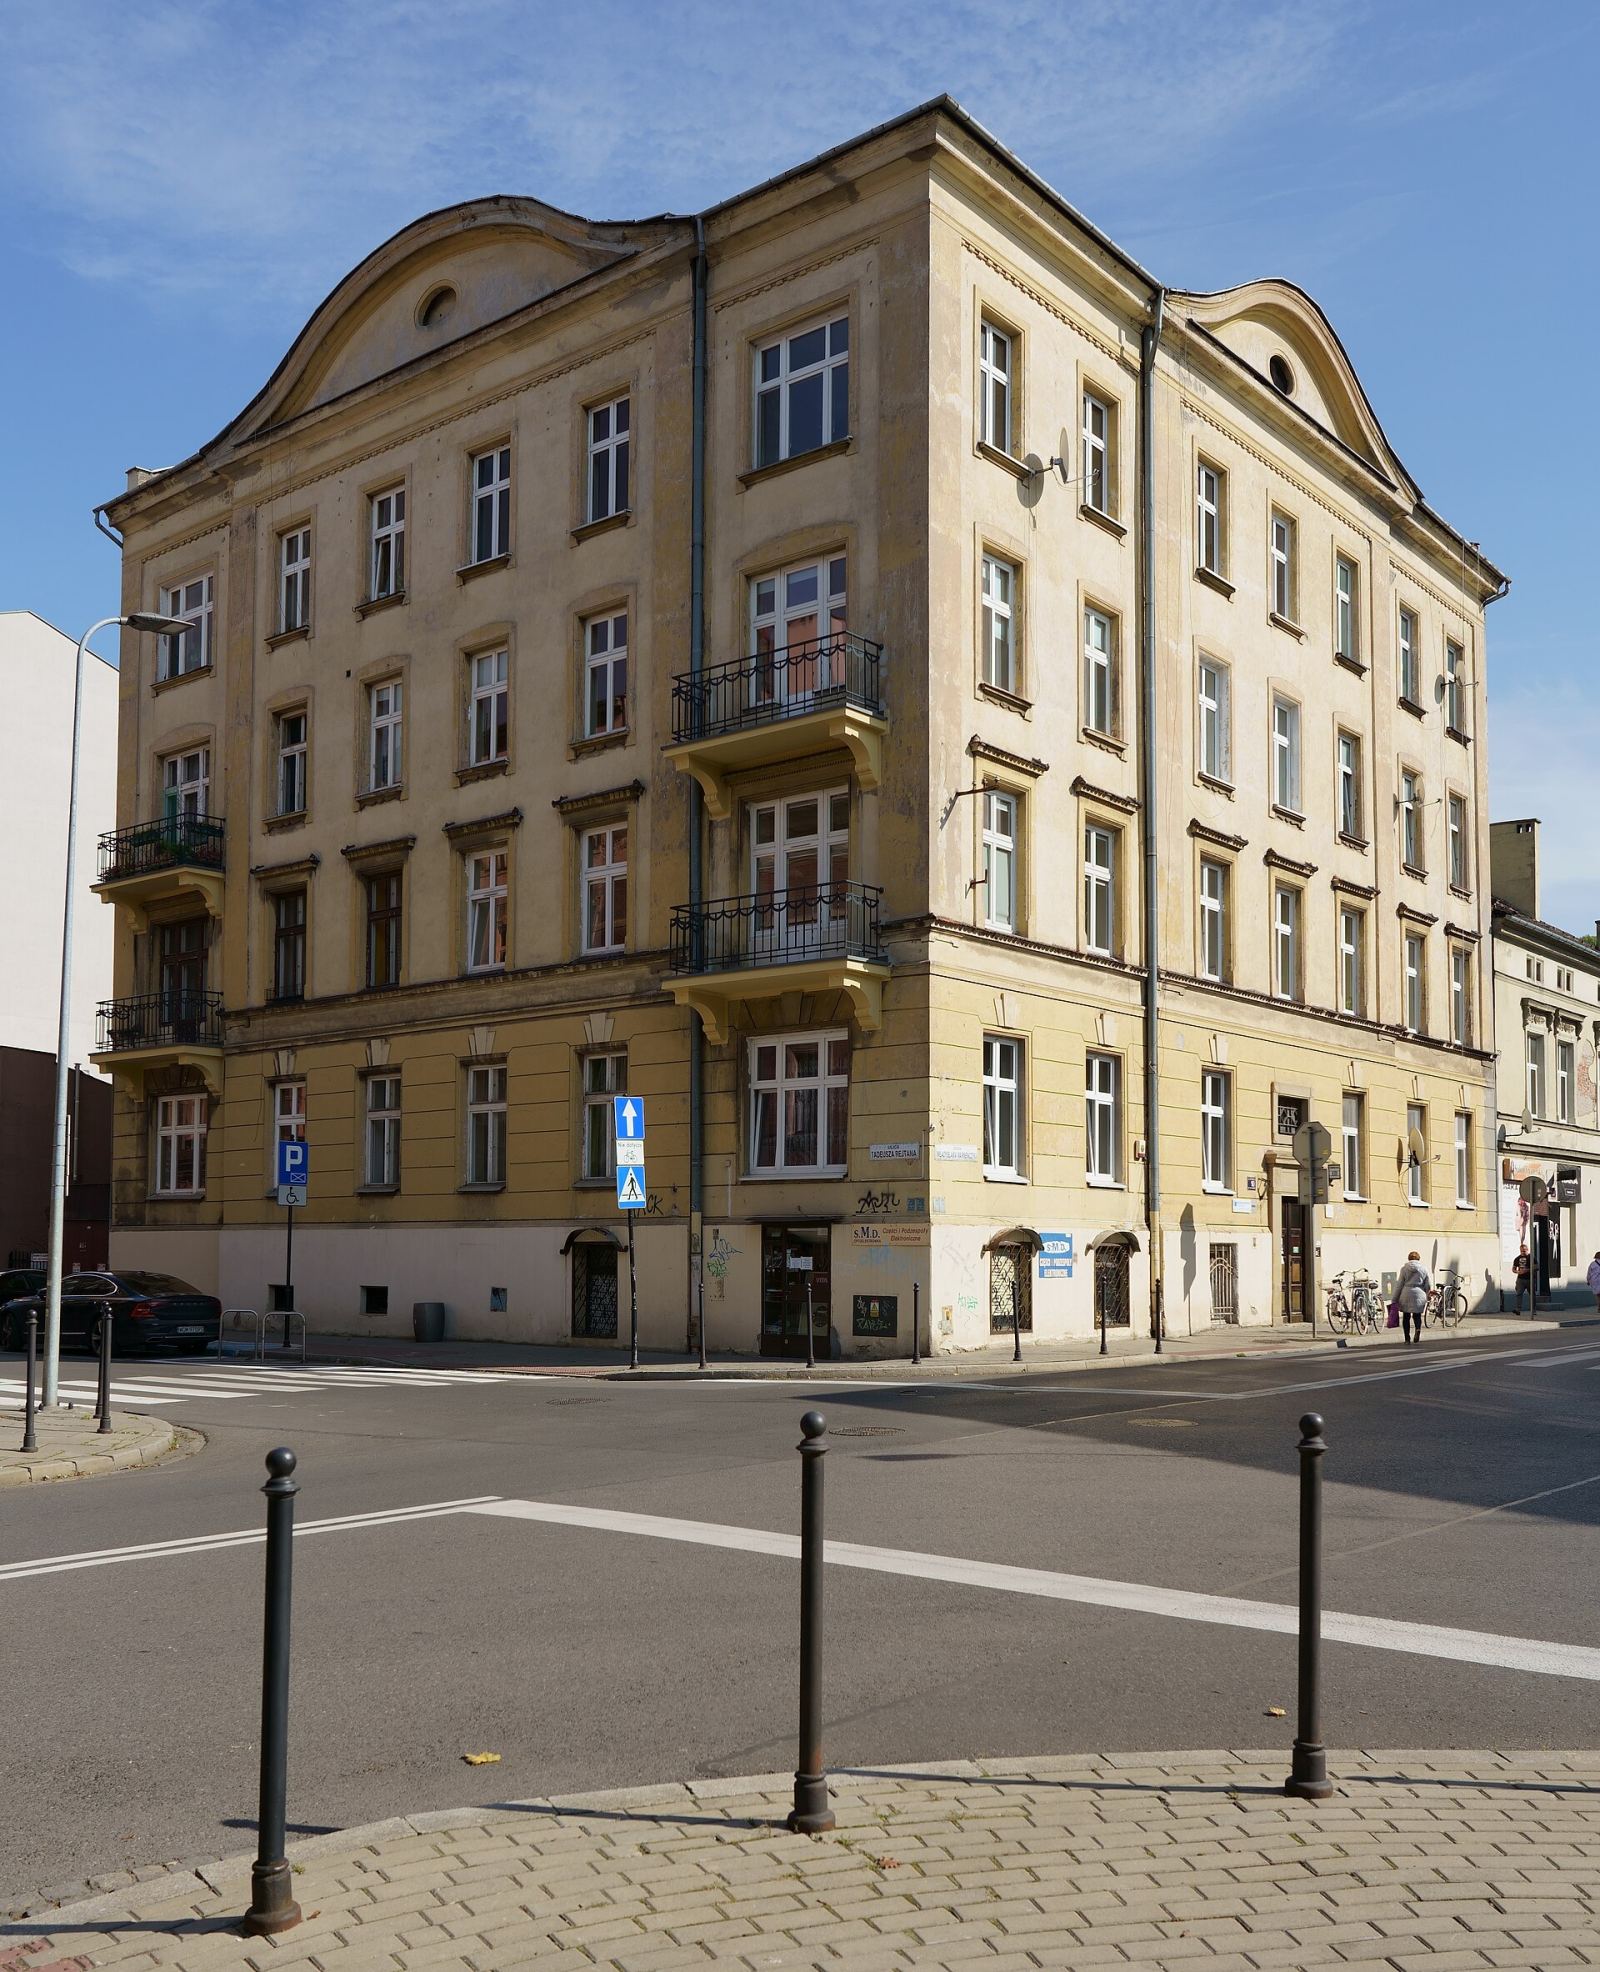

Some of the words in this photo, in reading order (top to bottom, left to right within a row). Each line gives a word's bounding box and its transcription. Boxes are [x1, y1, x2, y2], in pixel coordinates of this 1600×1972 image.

[285, 1145, 303, 1172] P
[871, 1150, 894, 1158] TADEUSZA
[895, 1149, 917, 1157] REJTANA
[853, 1226, 881, 1239] S.M.D.
